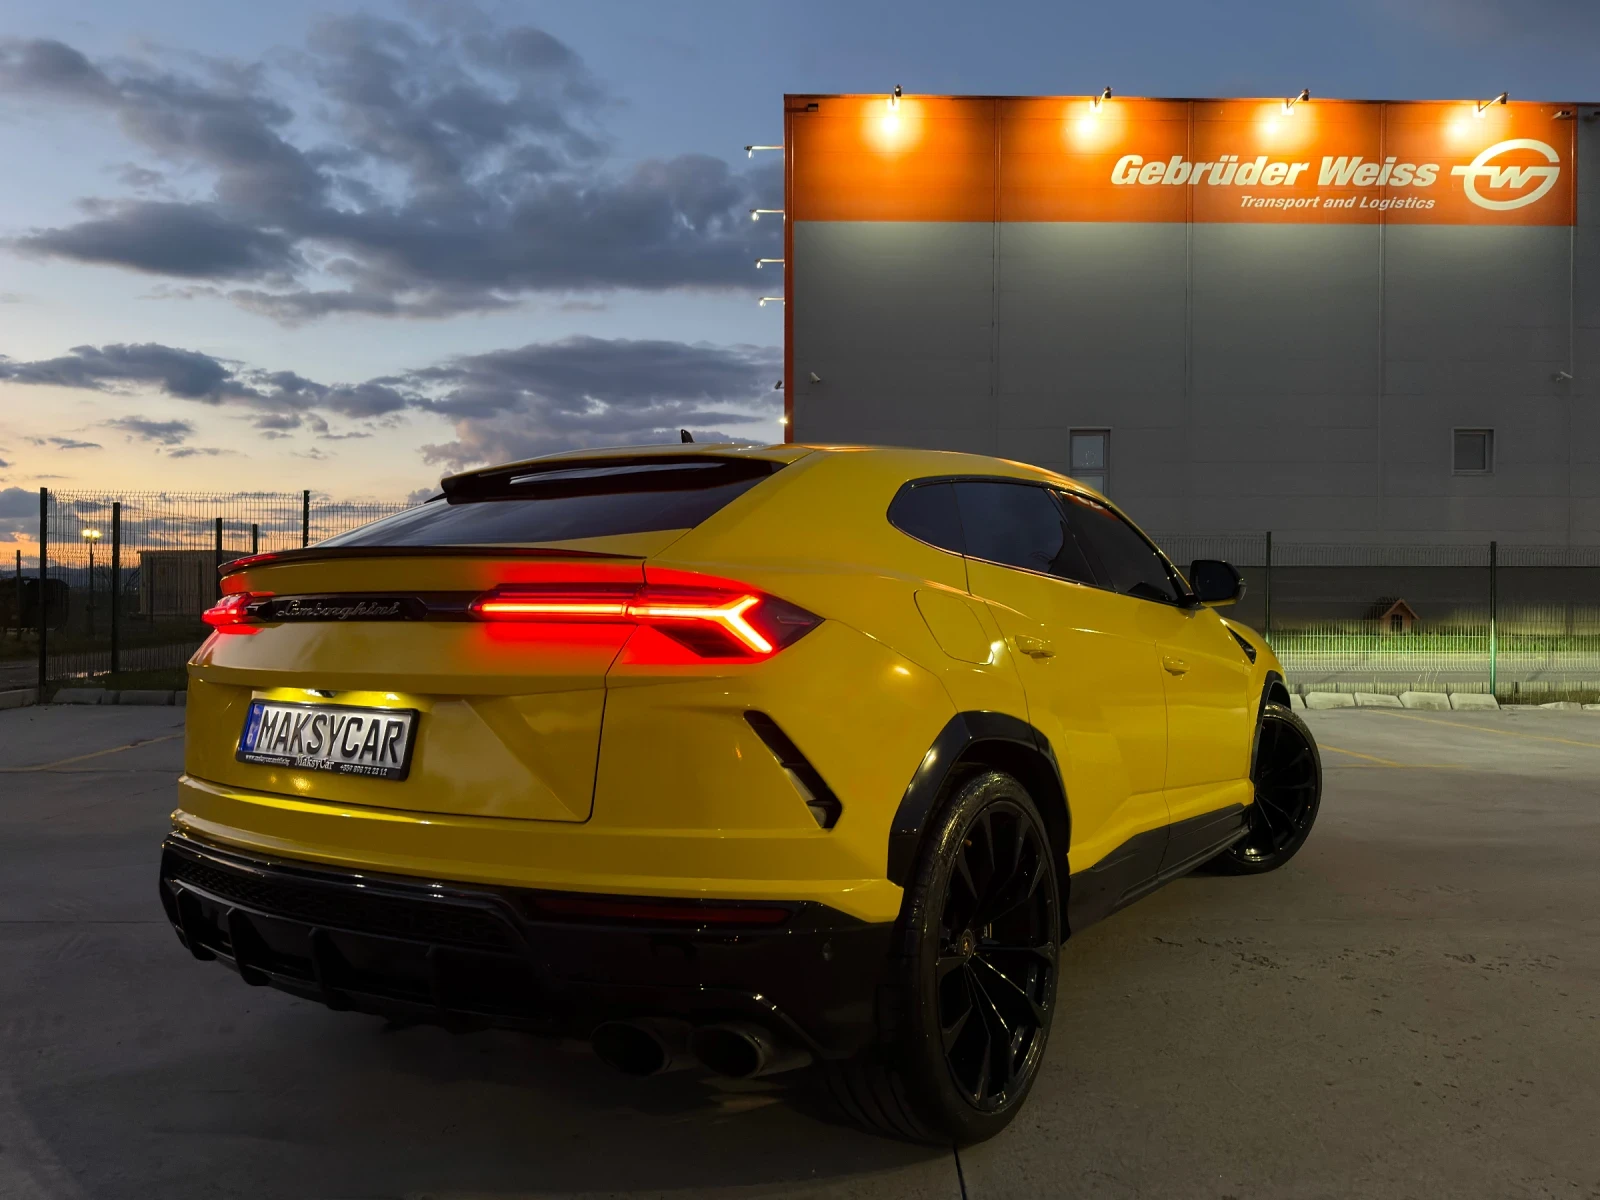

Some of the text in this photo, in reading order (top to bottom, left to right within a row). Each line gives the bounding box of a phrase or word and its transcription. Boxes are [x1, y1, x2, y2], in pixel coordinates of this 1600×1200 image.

[1111, 154, 1440, 187] Gebrüder Weiss
[1240, 195, 1436, 211] Transport and Logistics
[276, 599, 400, 619] Lamborghini
[256, 709, 404, 763] MAKSYCAR
[294, 754, 335, 771] MaksyCar
